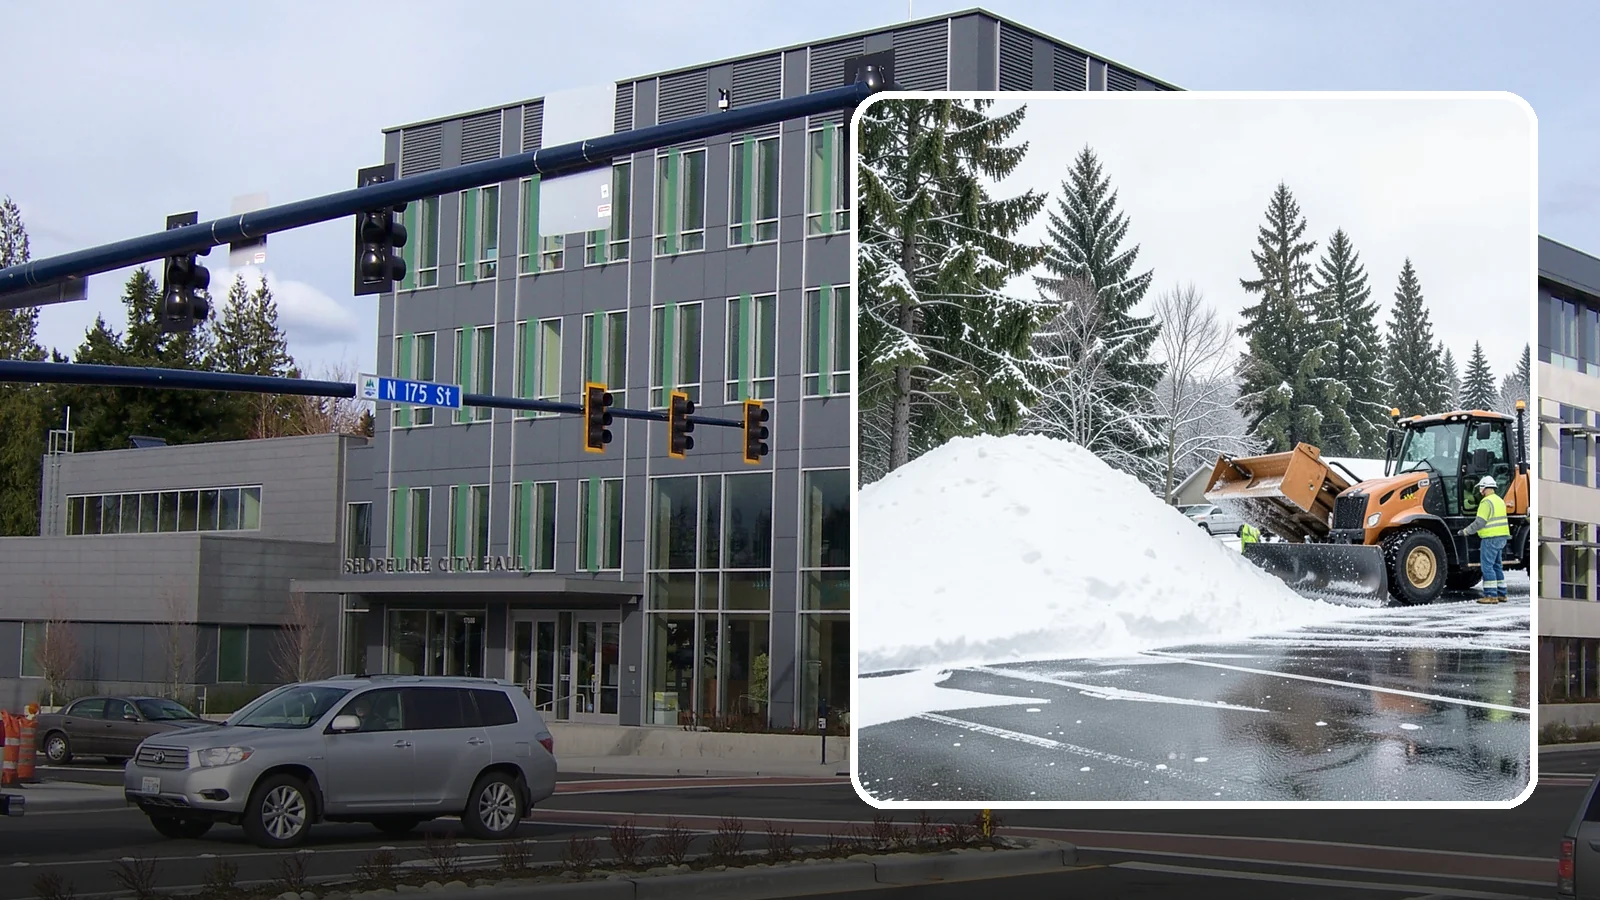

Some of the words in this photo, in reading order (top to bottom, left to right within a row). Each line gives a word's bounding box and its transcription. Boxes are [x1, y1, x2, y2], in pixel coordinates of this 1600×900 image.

[387, 380, 396, 400] N
[405, 382, 427, 403] 175
[436, 386, 451, 406] St
[343, 556, 432, 574] SHORELINE
[438, 555, 475, 572] CITY
[483, 555, 526, 572] HALL
